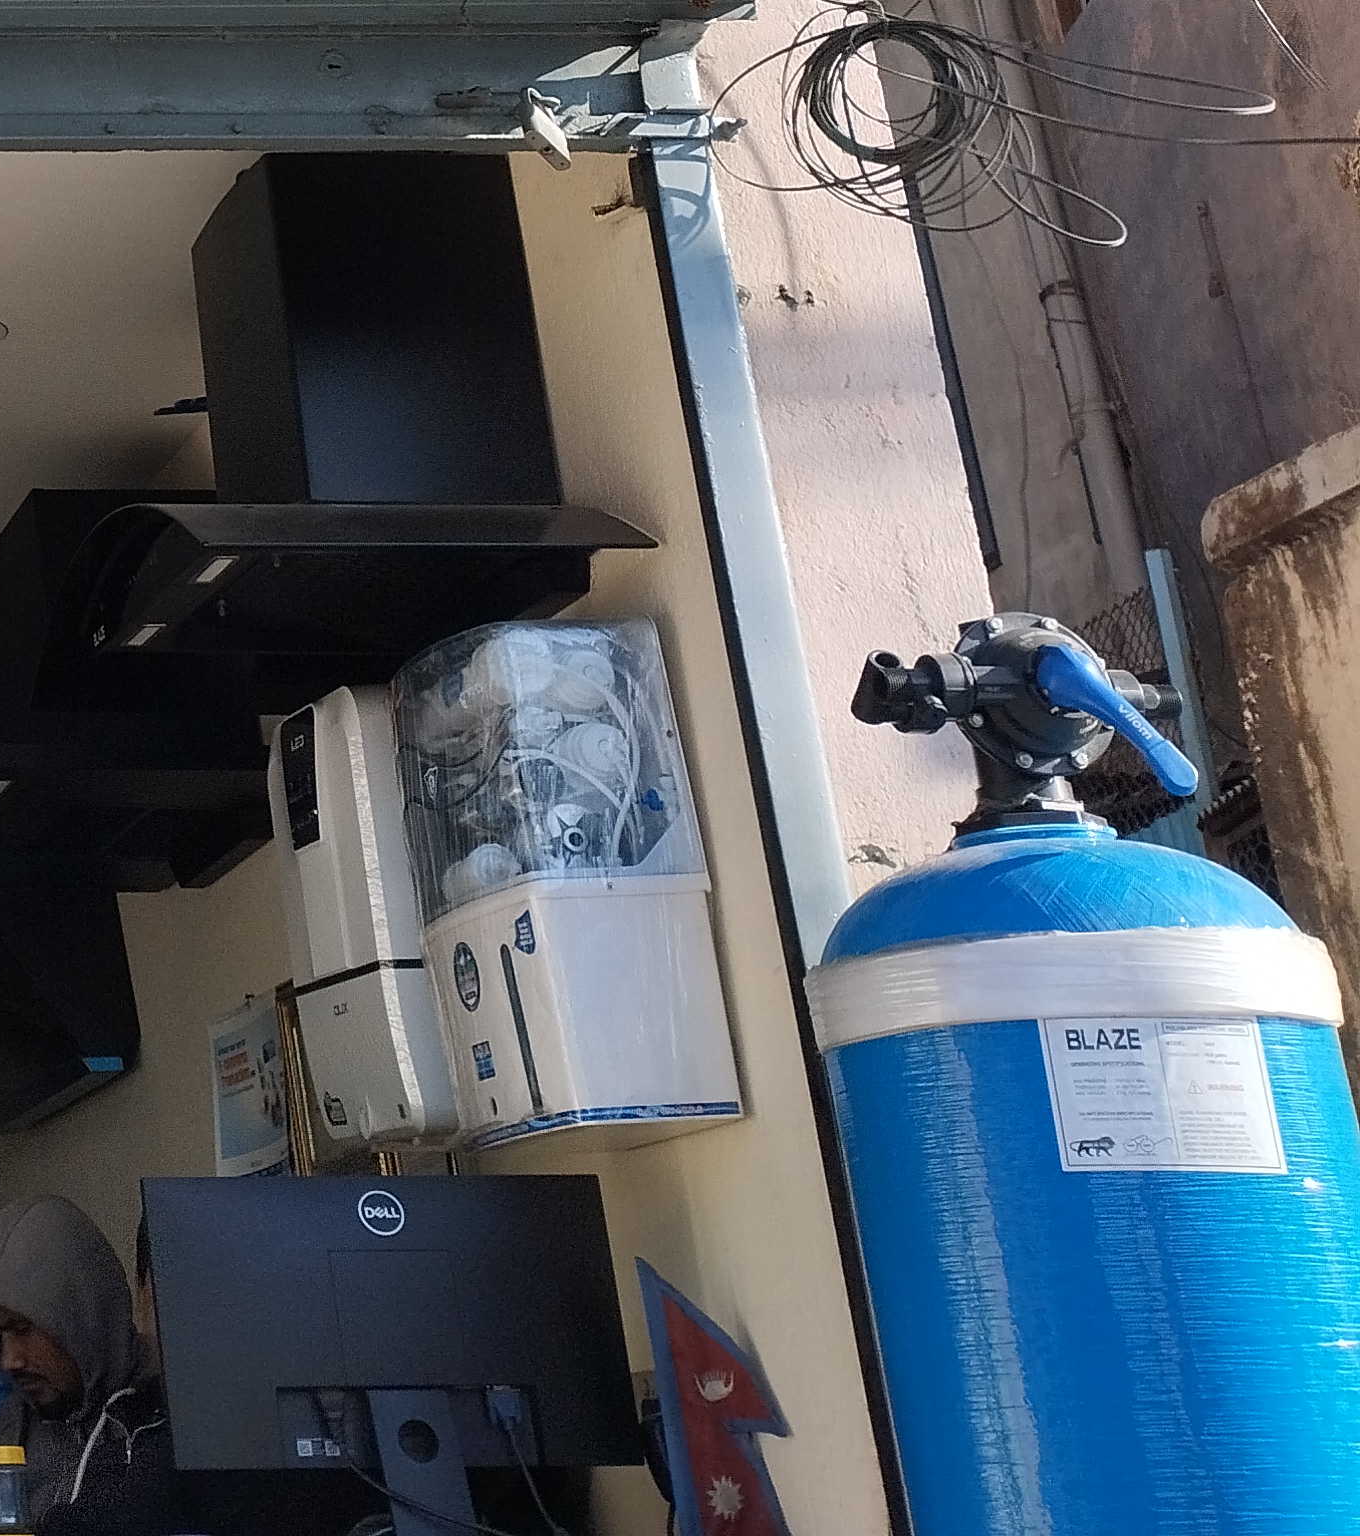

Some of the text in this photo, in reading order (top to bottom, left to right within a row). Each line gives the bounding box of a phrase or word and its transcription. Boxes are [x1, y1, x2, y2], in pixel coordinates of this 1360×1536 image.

[1118, 703, 1153, 741] vilom
[1064, 1028, 1142, 1051] BLAZE
[364, 1206, 400, 1219] DELL
